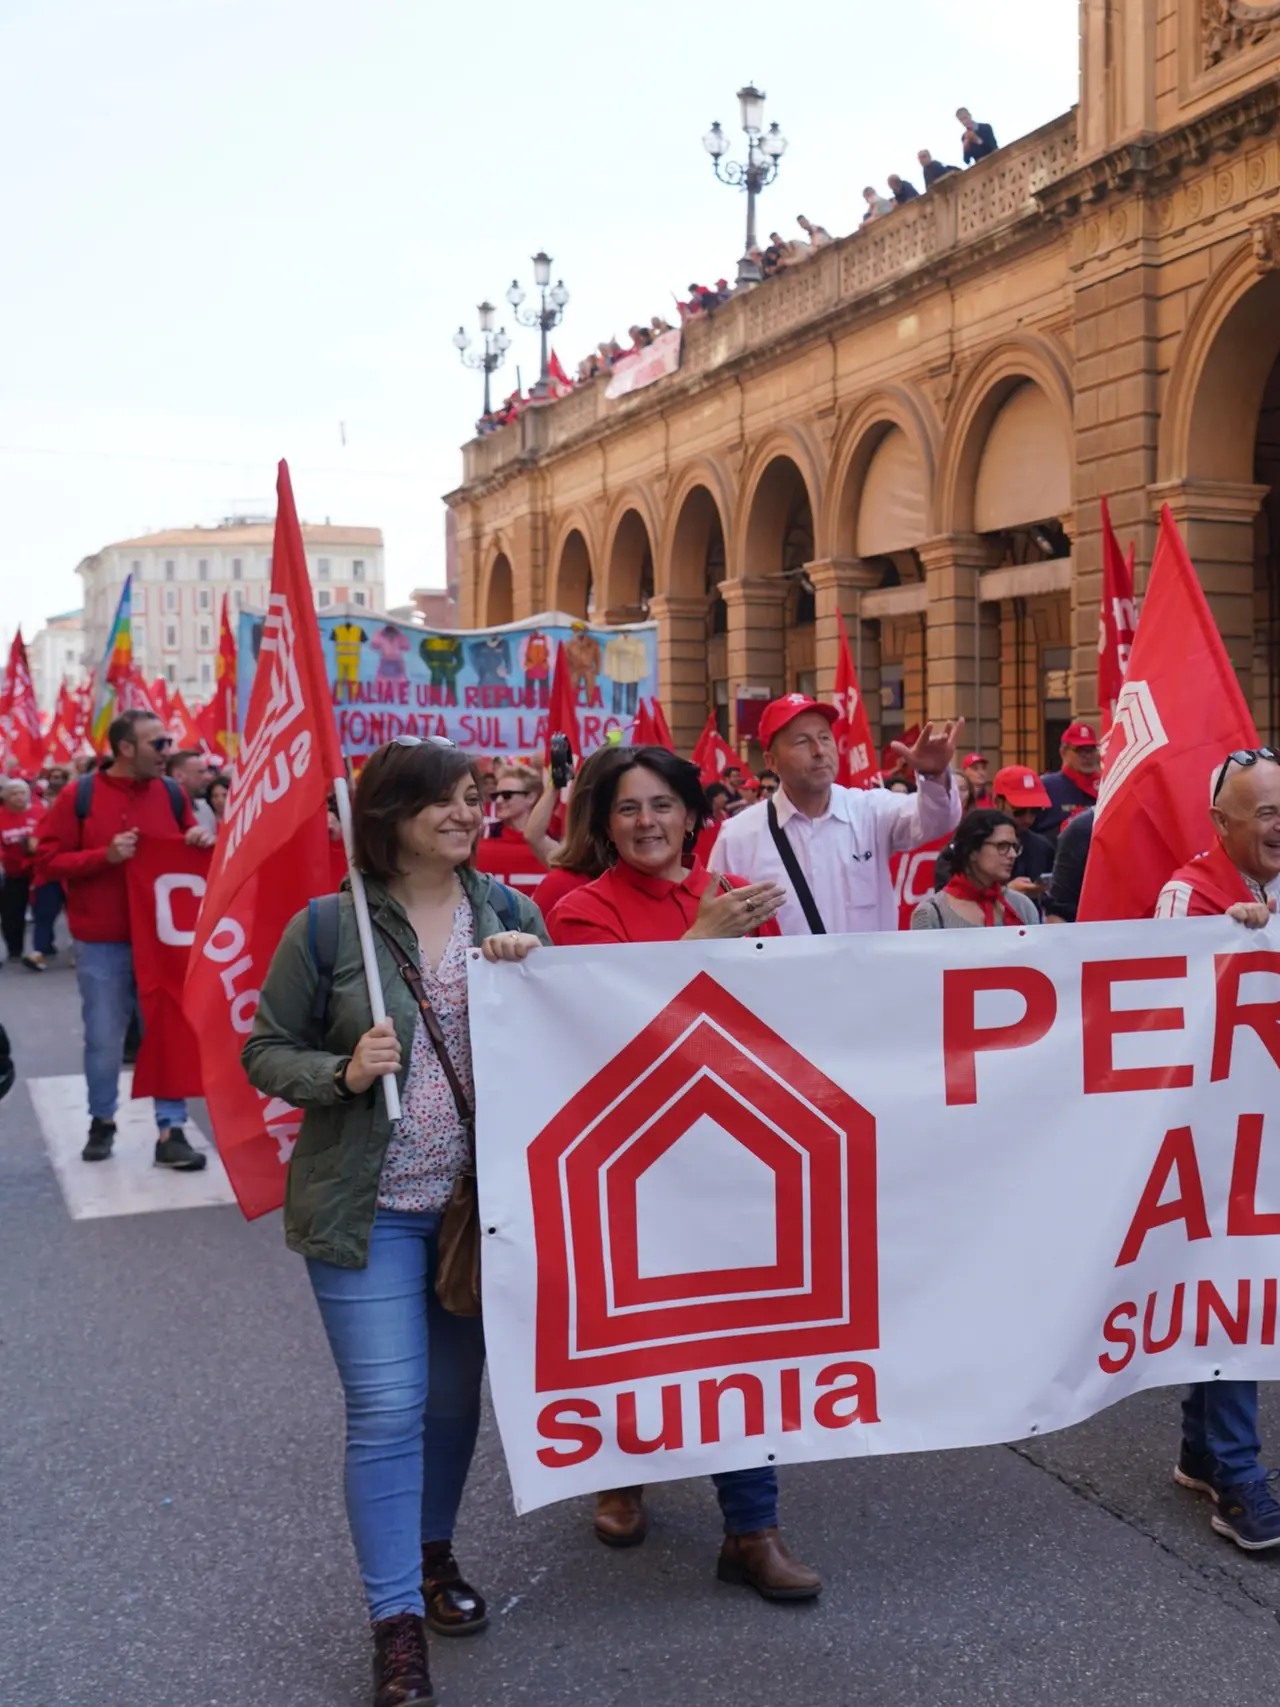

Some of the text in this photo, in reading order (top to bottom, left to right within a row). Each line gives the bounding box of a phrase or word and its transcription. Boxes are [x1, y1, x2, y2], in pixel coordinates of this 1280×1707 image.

[416, 684, 457, 709] UNA
[464, 685, 604, 709] REPUBBCA
[458, 714, 508, 749] SUL
[516, 713, 622, 749] LARO
